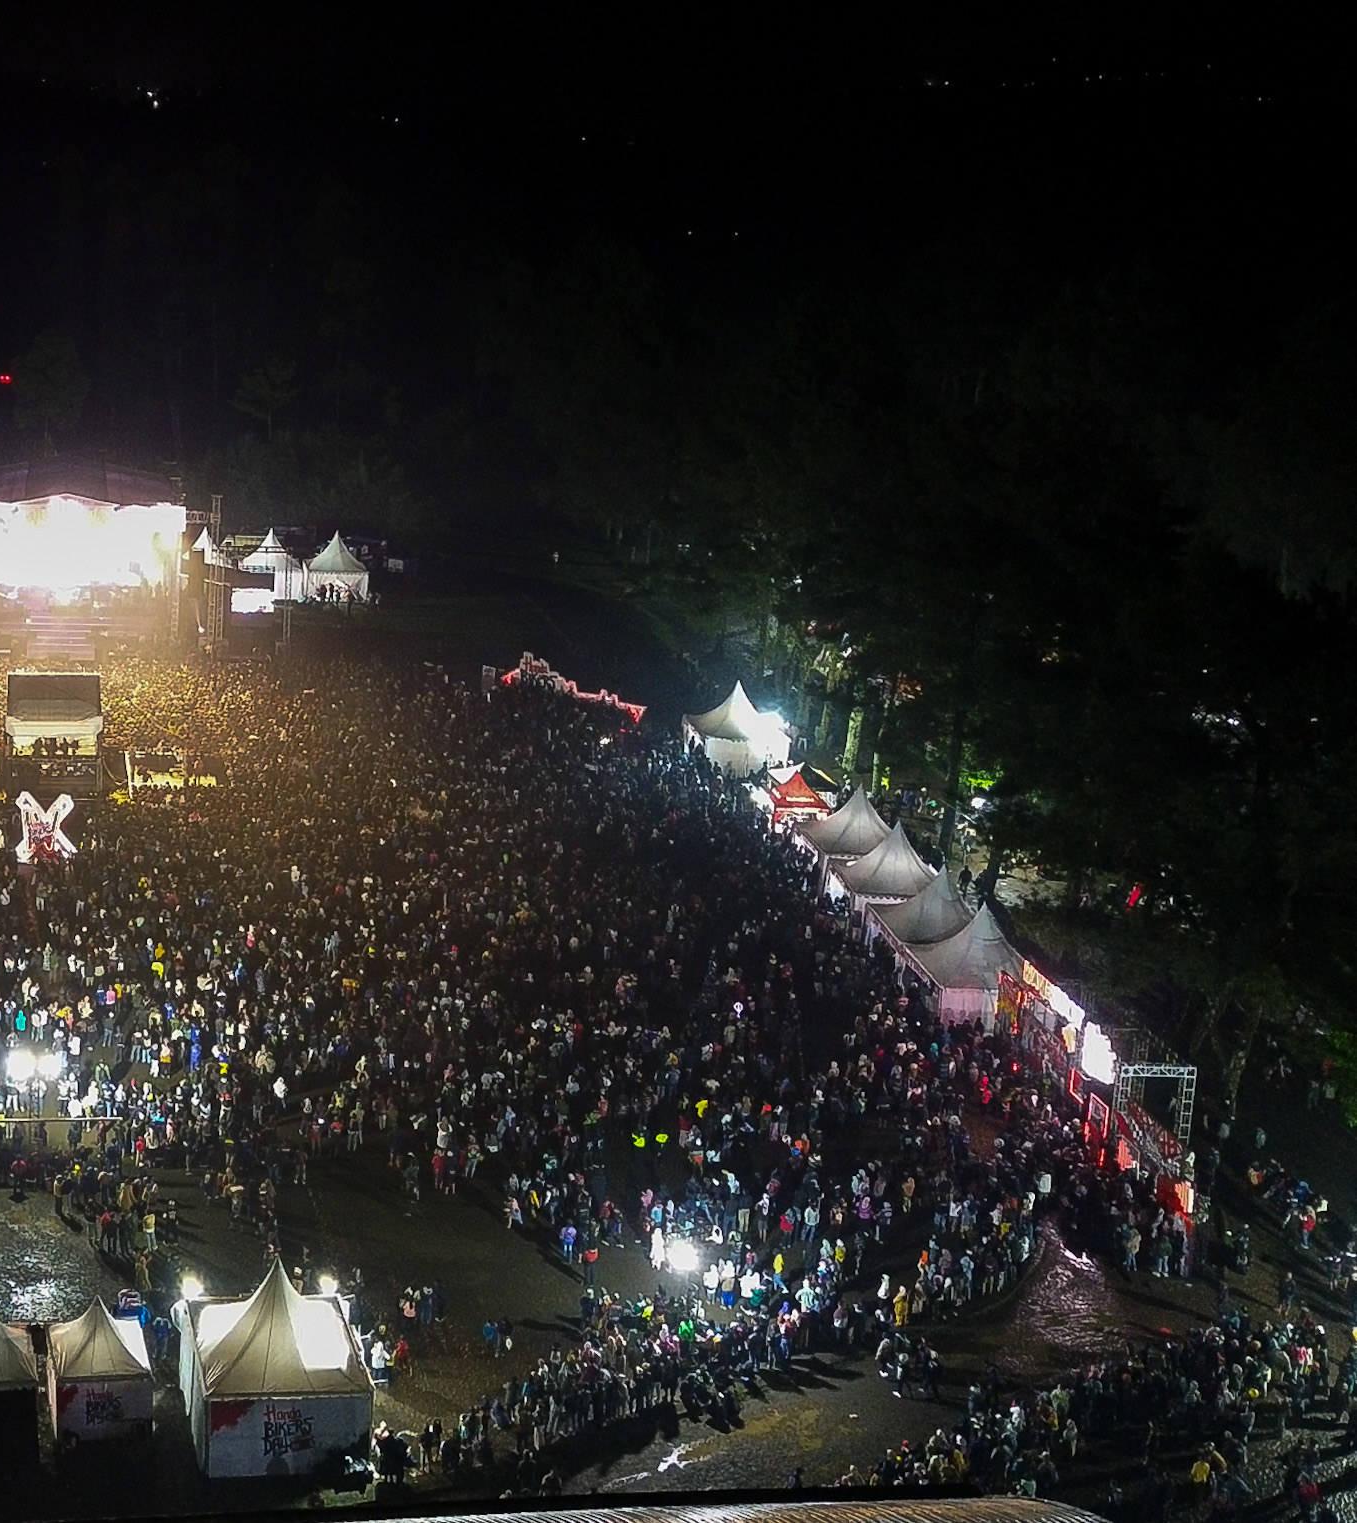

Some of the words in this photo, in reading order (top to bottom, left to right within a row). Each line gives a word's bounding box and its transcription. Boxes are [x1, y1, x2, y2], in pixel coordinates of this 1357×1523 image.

[264, 1403, 302, 1422] Honda
[263, 1416, 315, 1438] BIKERS
[261, 1435, 289, 1457] DAY
